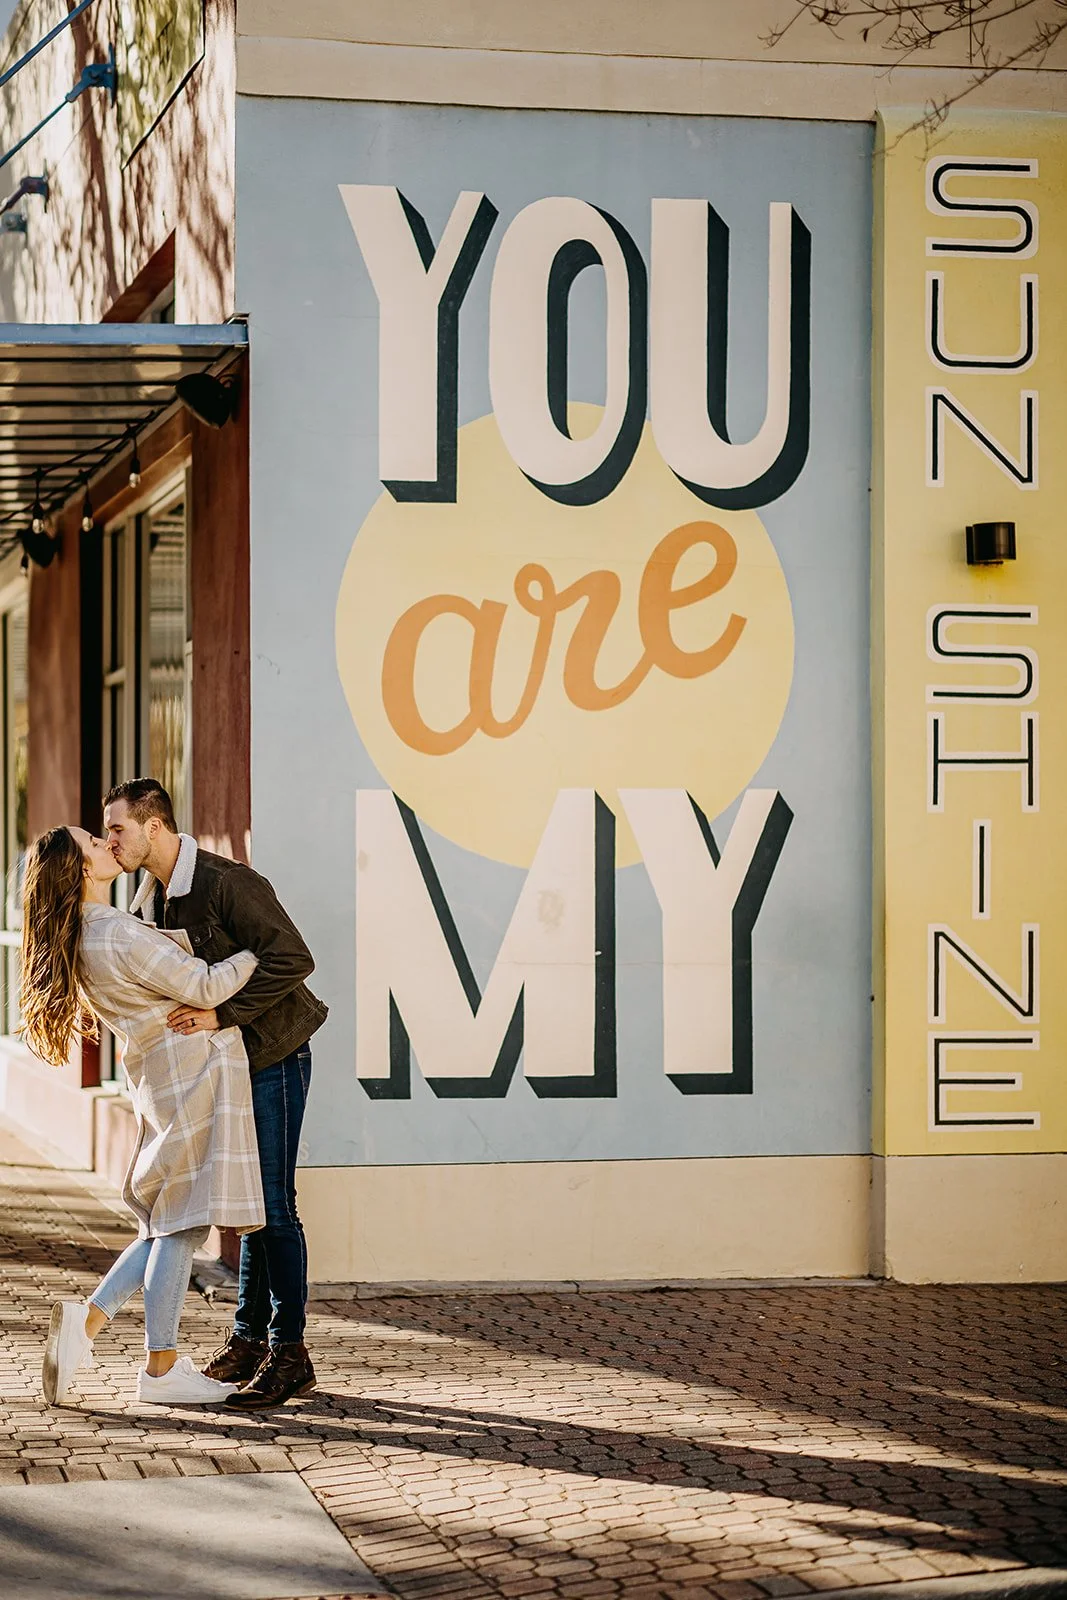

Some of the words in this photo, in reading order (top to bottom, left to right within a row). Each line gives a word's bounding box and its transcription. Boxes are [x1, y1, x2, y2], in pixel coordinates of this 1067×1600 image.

[337, 183, 812, 511] YOU
[381, 520, 747, 756] are
[355, 788, 795, 1100] MY
